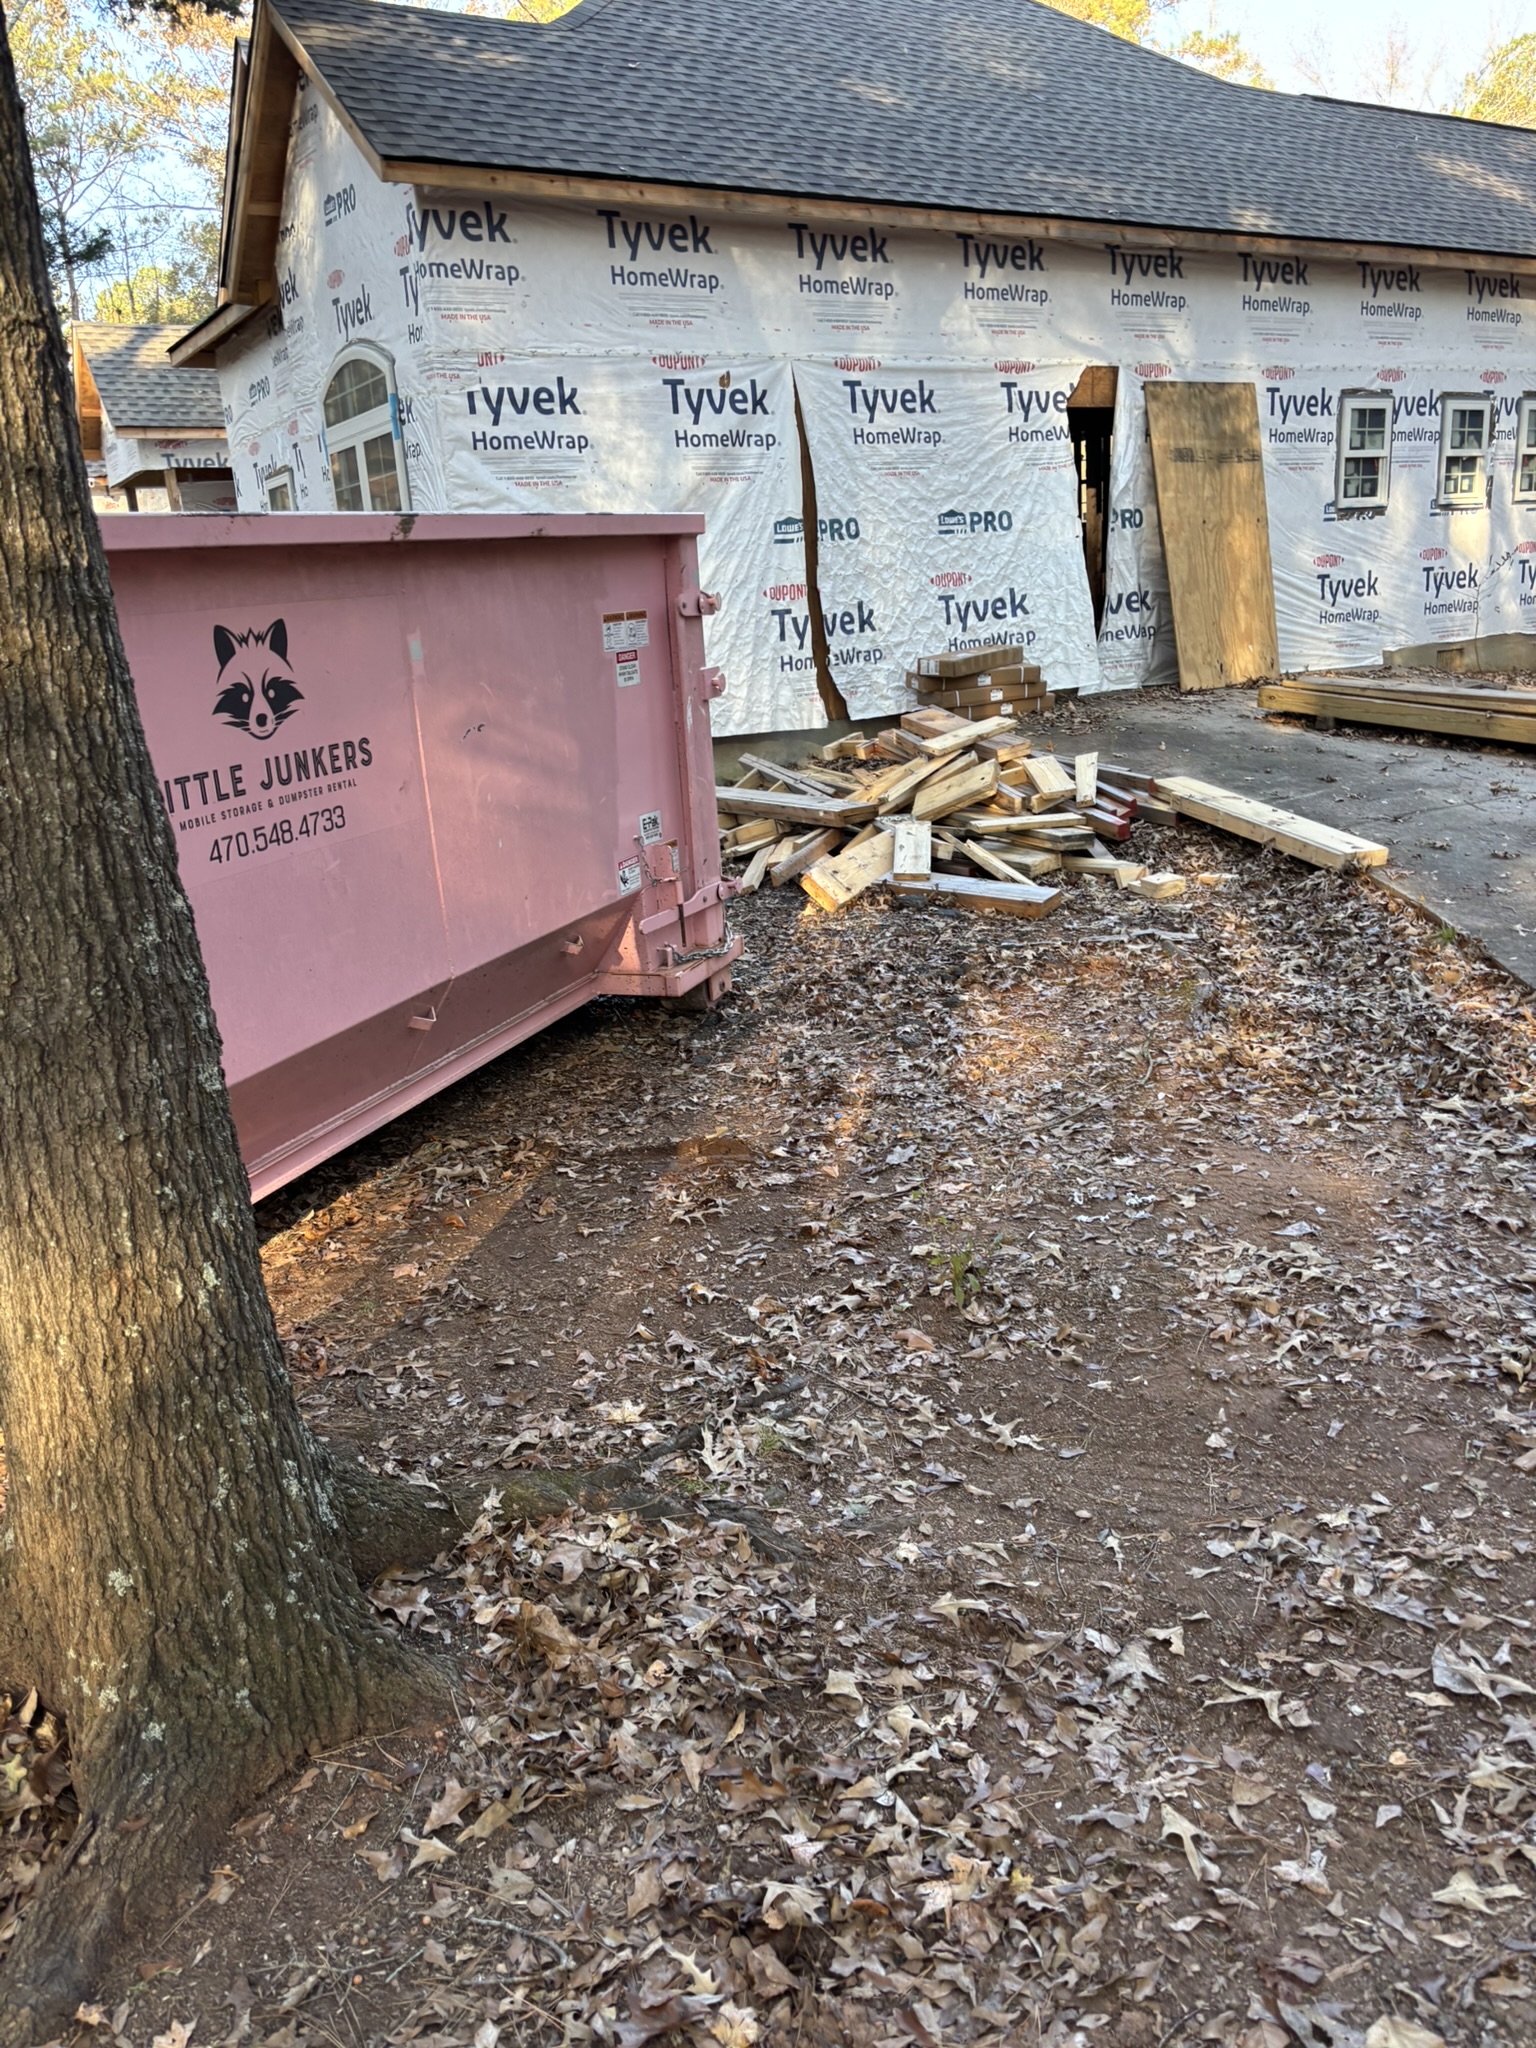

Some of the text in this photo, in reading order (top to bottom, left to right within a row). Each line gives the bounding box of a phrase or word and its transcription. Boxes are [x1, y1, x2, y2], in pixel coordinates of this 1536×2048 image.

[336, 184, 356, 220] PRO
[406, 201, 512, 252] Tyvek
[596, 209, 714, 262] Tyvek
[787, 222, 890, 270] Tyvek
[956, 233, 1045, 278] Tyvek
[414, 258, 520, 286] HomeWrap
[1104, 243, 1184, 286] Tyvek
[1238, 252, 1308, 292] Tyvek
[280, 267, 299, 309] vek
[610, 265, 720, 294] HomeWrap
[800, 274, 894, 300] HomeWrap
[1356, 261, 1420, 298] Tyvek
[1464, 270, 1520, 304] Tyvek
[964, 282, 1048, 306] HomeWrap
[1111, 288, 1186, 312] HomeWrap
[1242, 294, 1310, 317] HomeWrap
[332, 284, 373, 342] Tyvek
[1360, 300, 1422, 322] HomeWrap
[1466, 306, 1522, 326] HomeWrap
[840, 357, 876, 372] DUPONT
[998, 360, 1031, 374] DUPONT
[1139, 363, 1168, 378] DUPONT
[257, 376, 270, 402] PRO
[662, 378, 769, 426] Tyvek
[842, 380, 936, 424] Tyvek
[224, 404, 234, 426] RO
[1266, 387, 1332, 424] Tyvek
[472, 430, 589, 454] HomeWrap
[674, 429, 776, 450] HomeWrap
[854, 427, 942, 448] HomeWrap
[1009, 426, 1070, 442] HomeW
[1268, 428, 1334, 446] HomeWrap
[1391, 428, 1440, 444] omeWrap
[818, 517, 860, 542] PRO
[969, 510, 1013, 533] PRO
[1317, 554, 1341, 568] DUPONT
[1422, 548, 1445, 560] DUPONT
[769, 584, 807, 601] DUPONT
[935, 572, 967, 588] DUPONT
[1316, 570, 1378, 607] Tyvek
[1422, 562, 1478, 598] Tyvek
[938, 588, 1030, 632] Tyvek
[1106, 584, 1152, 616] vek
[1424, 598, 1479, 616] HomeWrap
[770, 600, 876, 650] Tyvek
[1320, 608, 1379, 624] HomeWrap
[948, 630, 1036, 652] HomeWrap
[618, 652, 636, 661] DANGER
[164, 737, 373, 814] ITTLE JUNKERS
[179, 778, 358, 832] MOBILE STORAGE & DUMPSTER RENTAL
[209, 805, 346, 864] 470.548.4733
